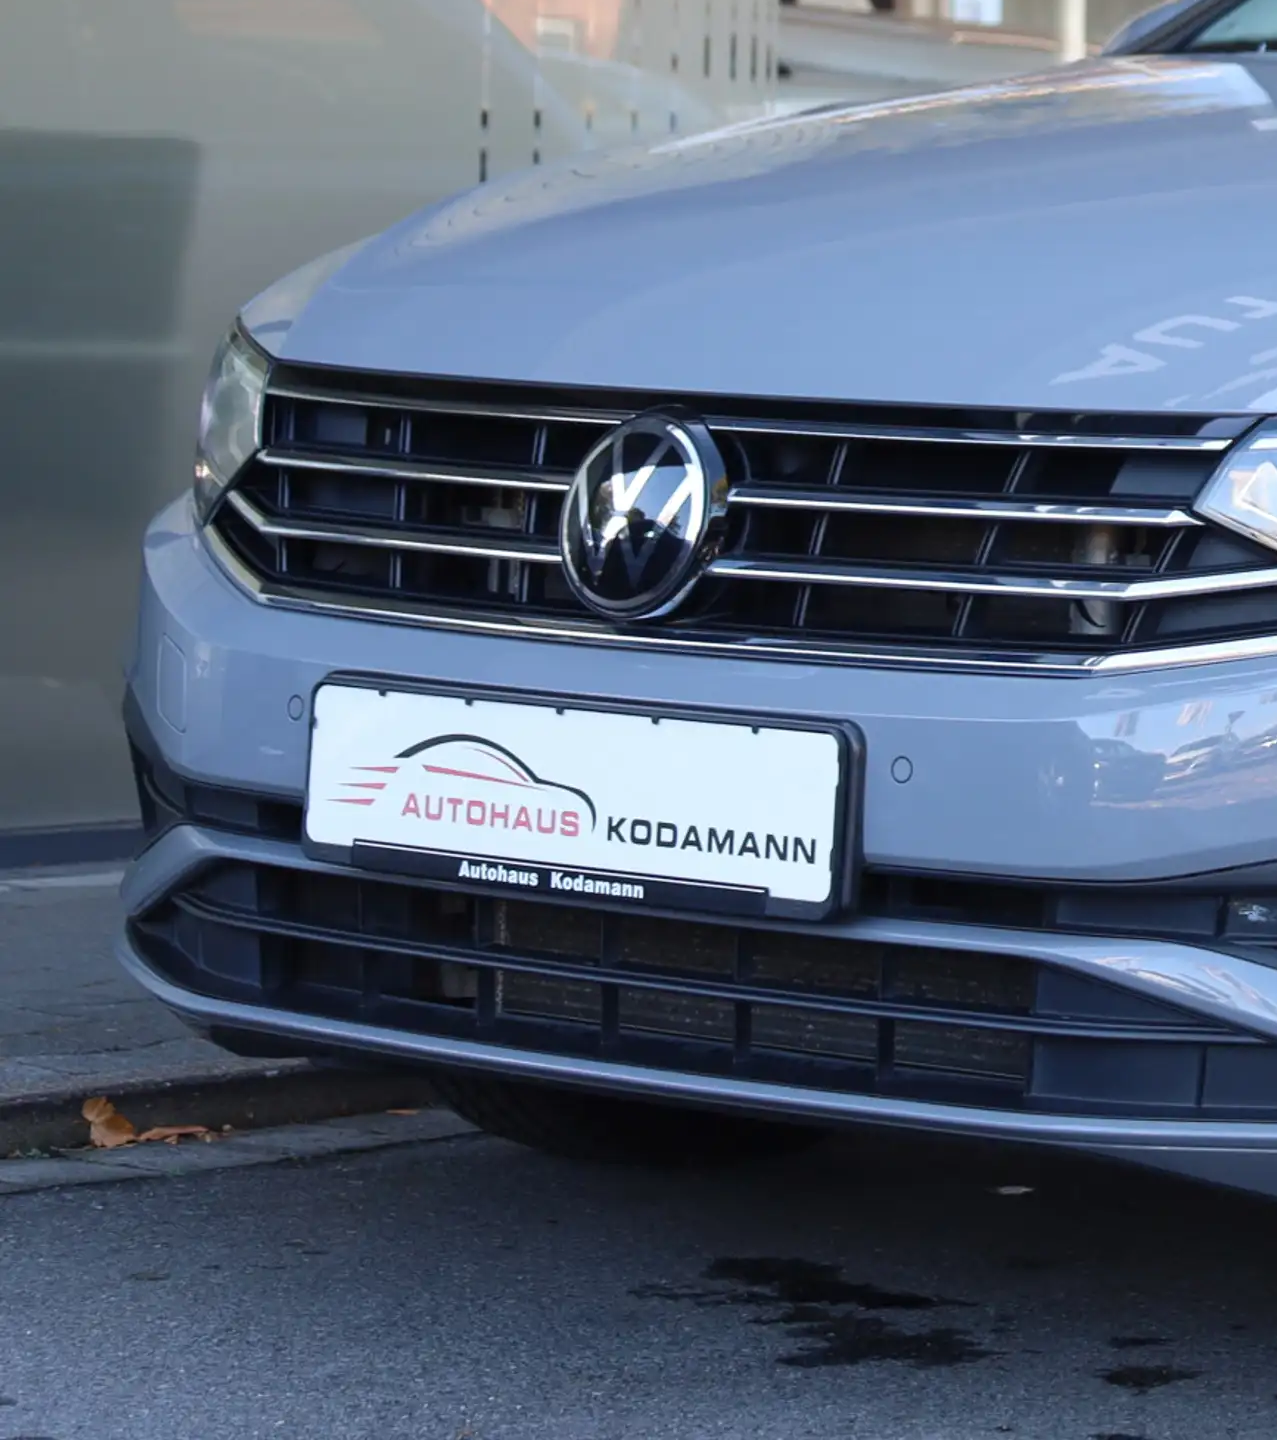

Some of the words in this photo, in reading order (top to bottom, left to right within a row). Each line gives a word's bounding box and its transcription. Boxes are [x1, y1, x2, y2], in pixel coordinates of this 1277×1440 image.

[401, 792, 579, 837] AUTOHAUS
[607, 816, 817, 865] KODAMANN
[459, 860, 539, 888] Autohaus
[550, 871, 645, 900] Kodamann
